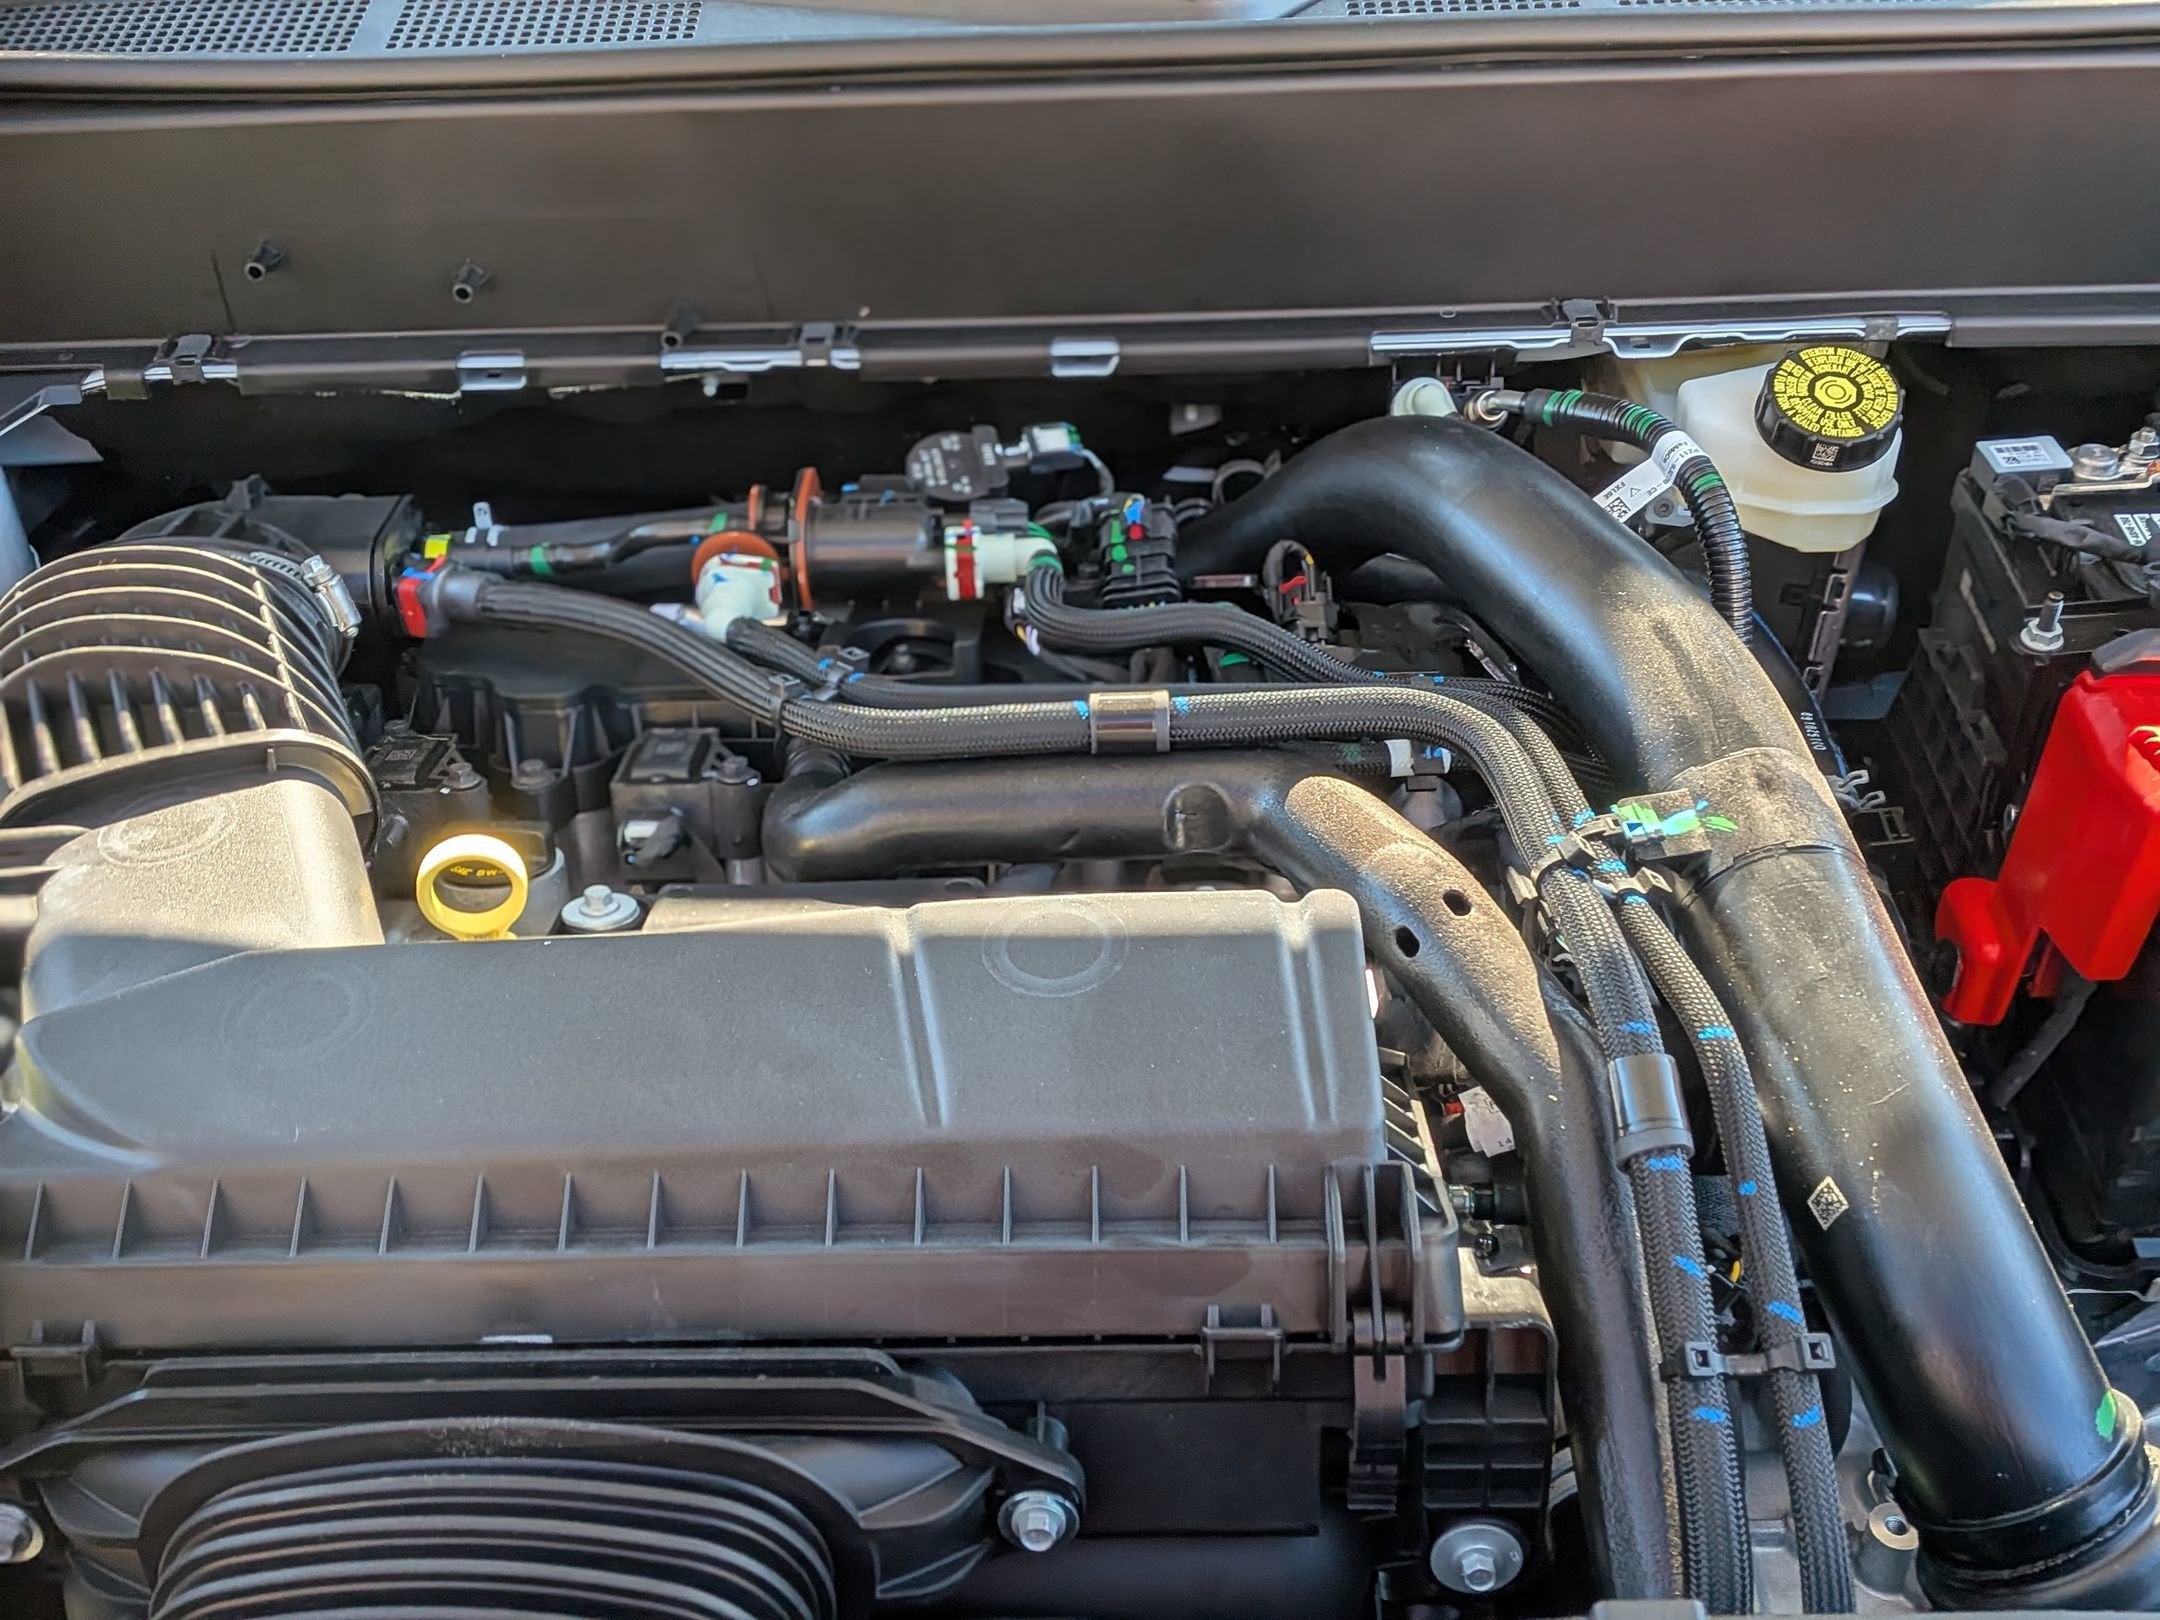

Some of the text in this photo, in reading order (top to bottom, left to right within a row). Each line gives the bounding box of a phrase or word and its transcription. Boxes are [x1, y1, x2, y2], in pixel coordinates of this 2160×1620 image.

[1867, 360, 1880, 370] LE
[1774, 375, 1786, 391] FLUID
[1784, 408, 1796, 416] A
[1790, 413, 1820, 433] SEALED
[1820, 426, 1865, 437] CONTAINER
[1800, 397, 1824, 416] CLEAN
[1822, 410, 1854, 420] FILLER
[1818, 418, 1834, 428] USE
[1837, 419, 1857, 428] ONLY
